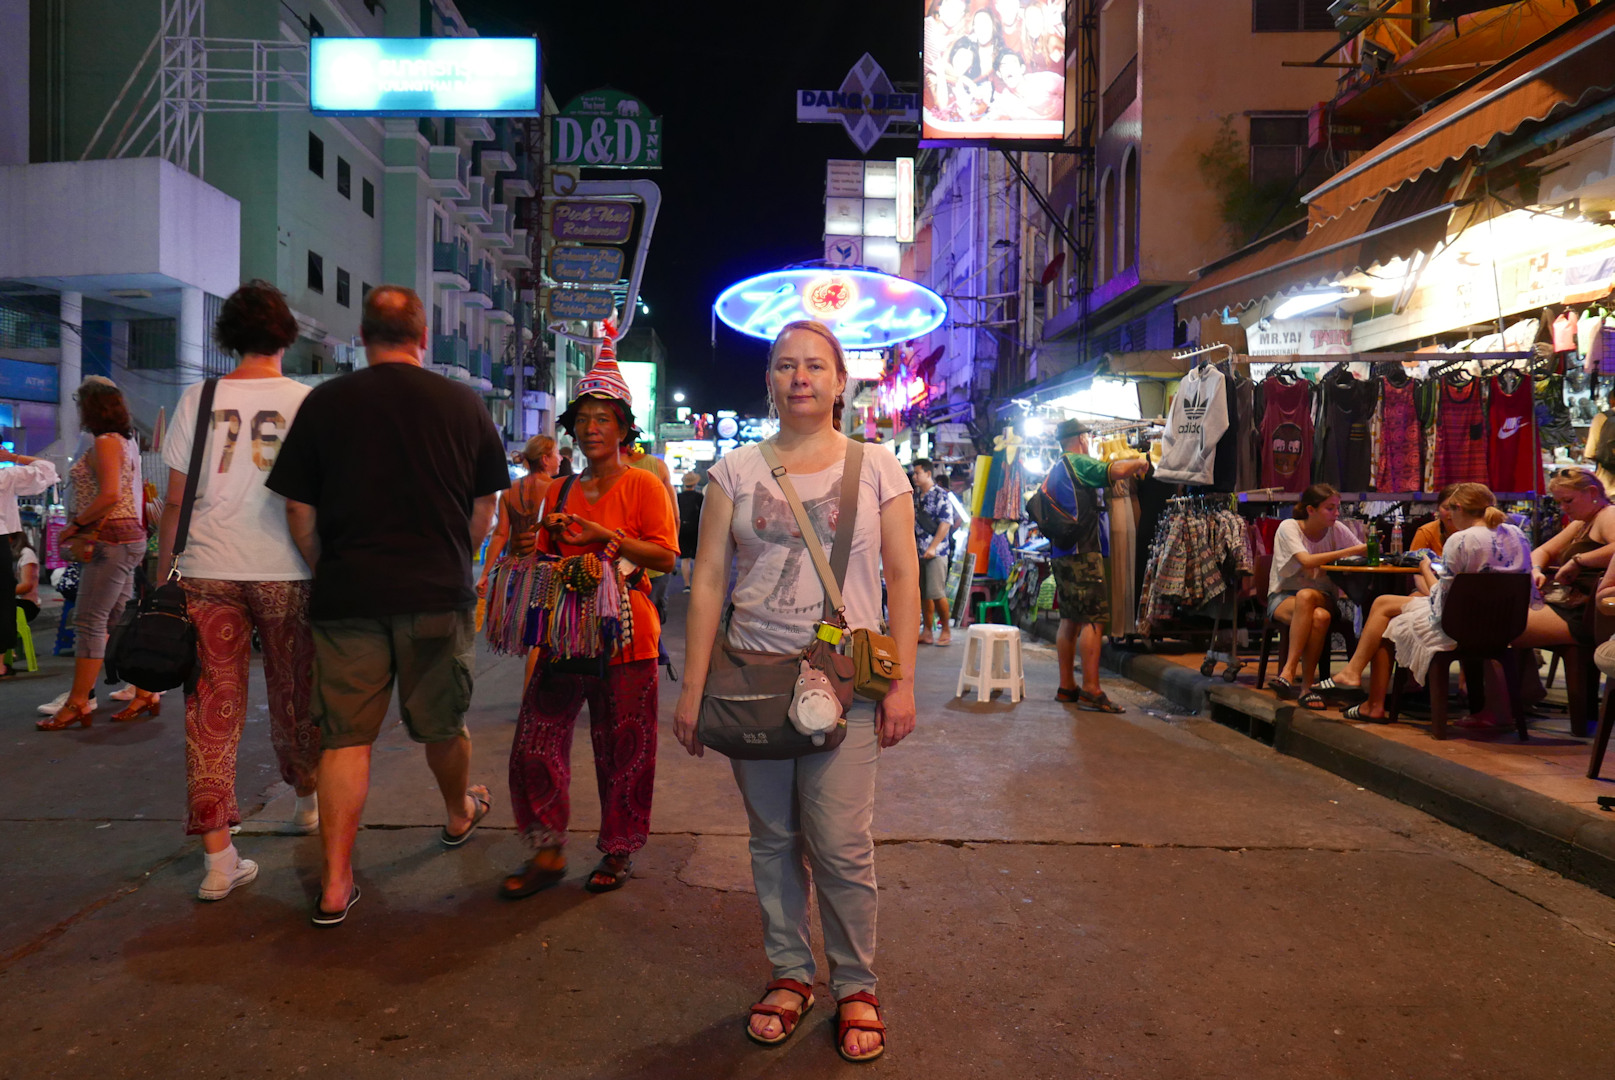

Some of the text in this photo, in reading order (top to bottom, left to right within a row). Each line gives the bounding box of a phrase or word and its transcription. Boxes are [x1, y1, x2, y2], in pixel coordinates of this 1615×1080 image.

[555, 117, 659, 164] D&D INN
[211, 409, 286, 474] 76
[1178, 421, 1201, 434] adid
